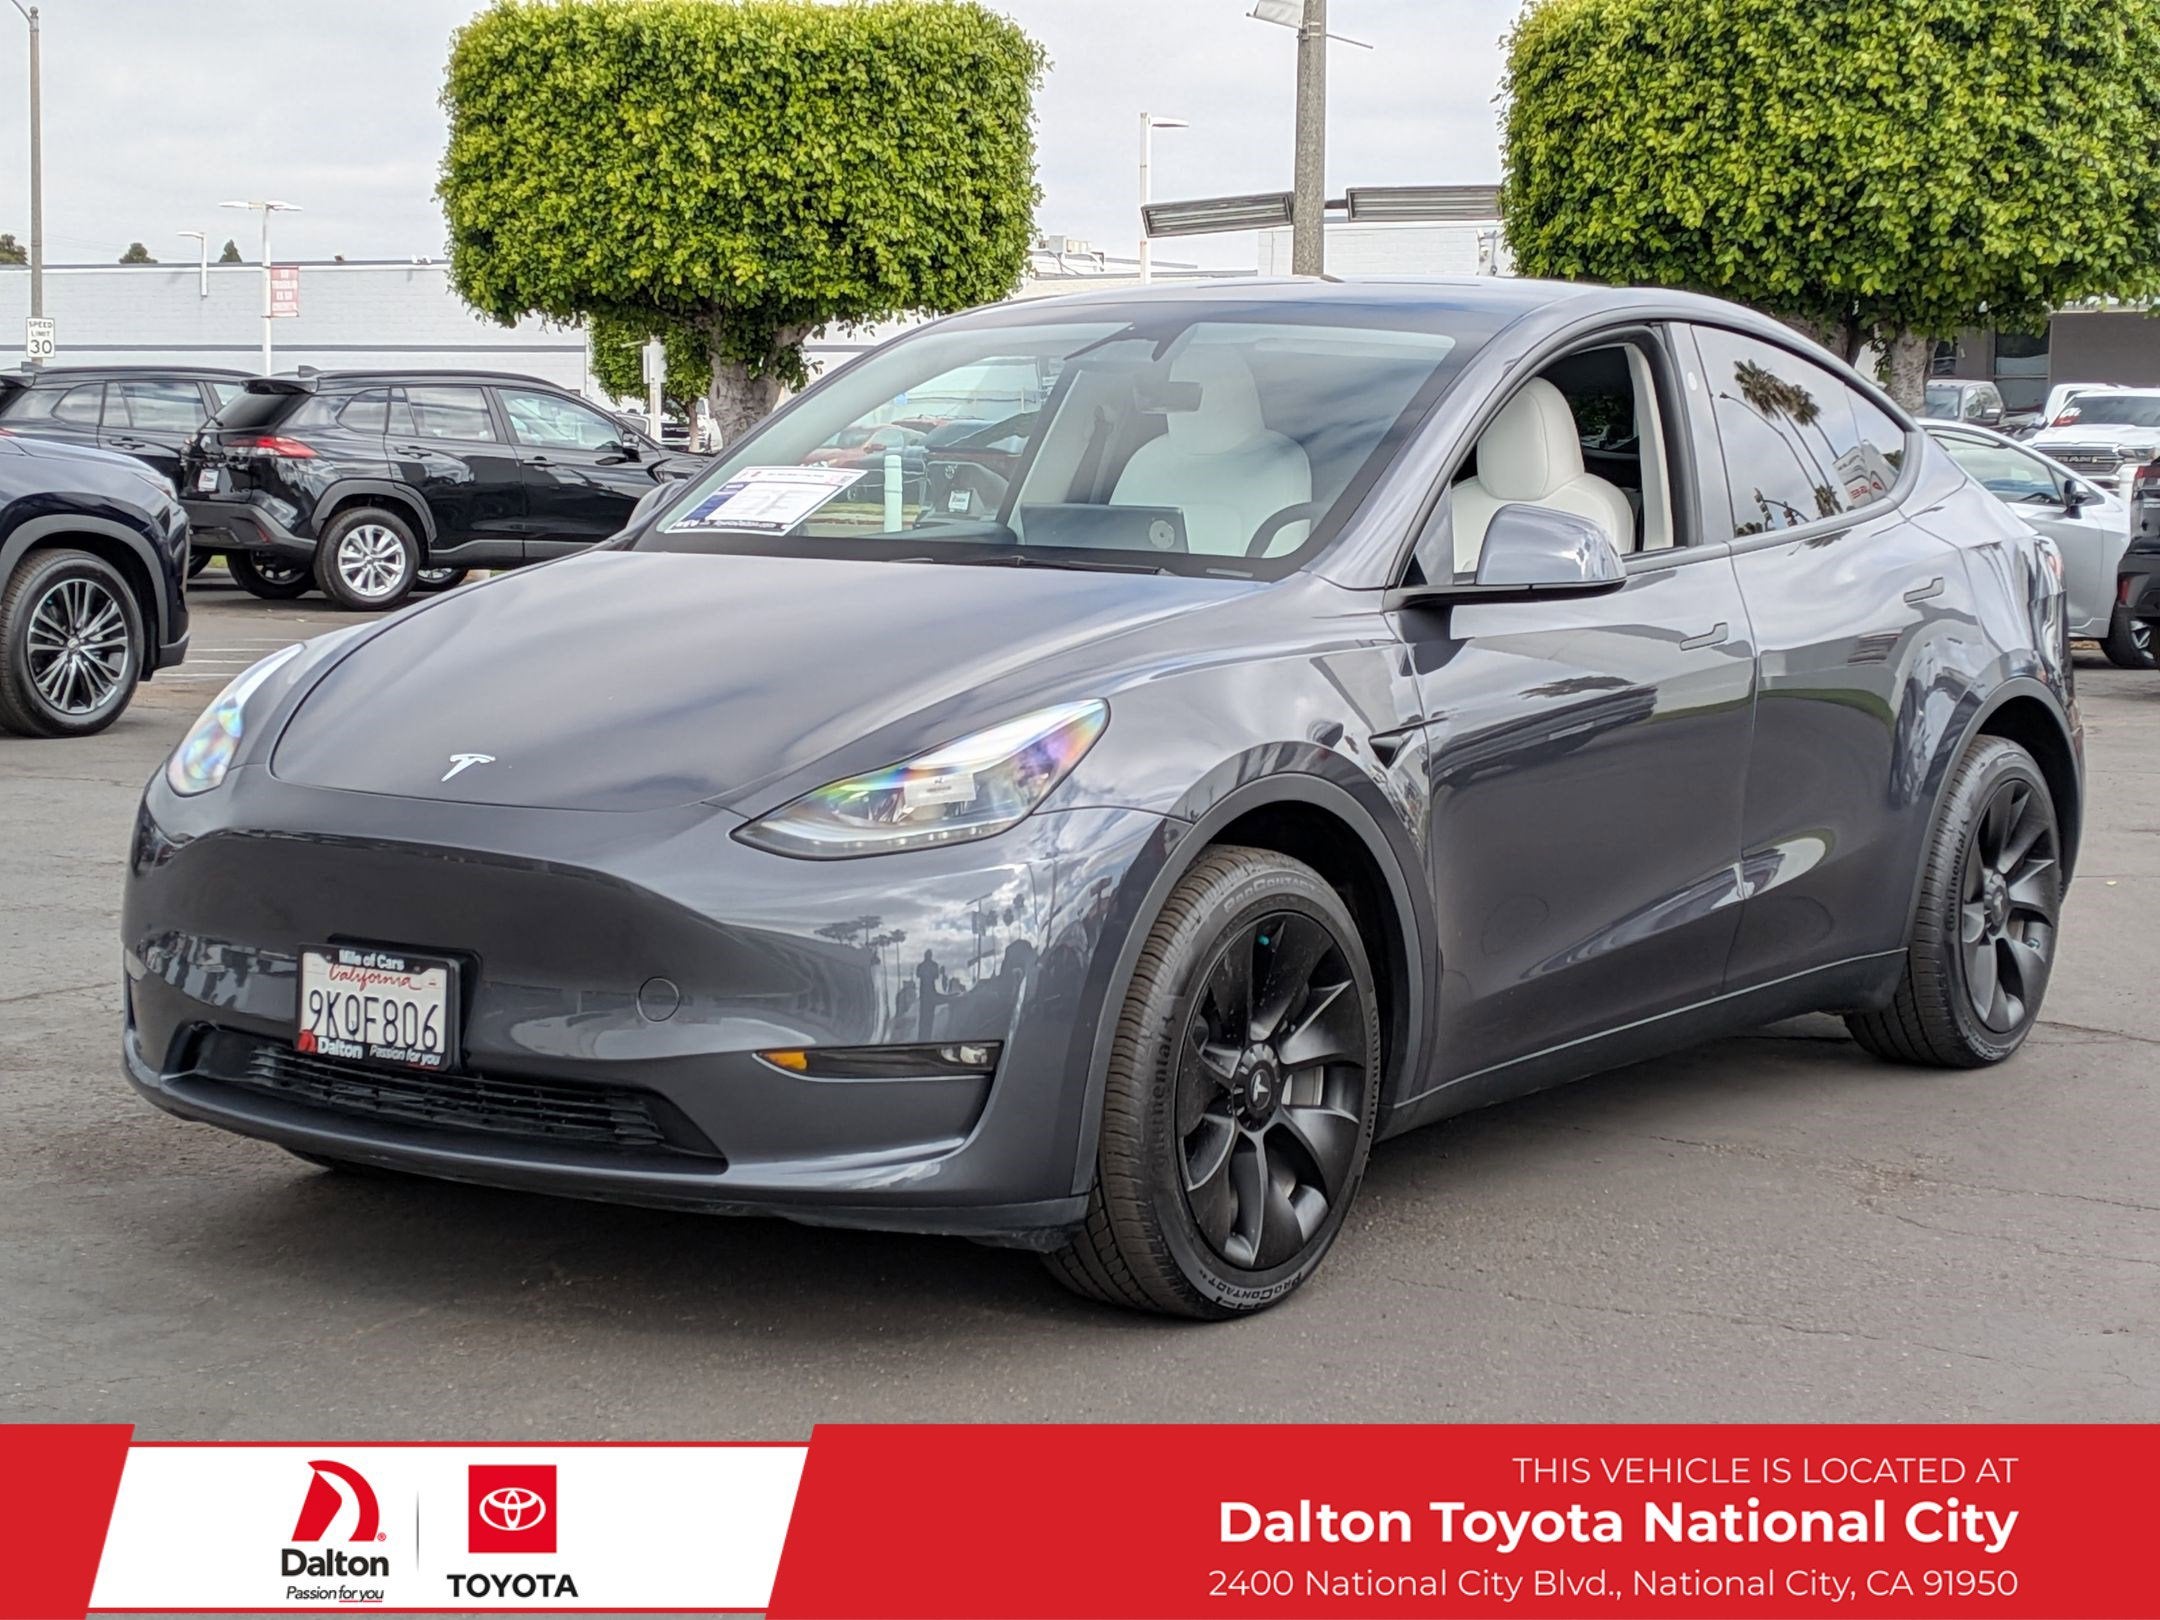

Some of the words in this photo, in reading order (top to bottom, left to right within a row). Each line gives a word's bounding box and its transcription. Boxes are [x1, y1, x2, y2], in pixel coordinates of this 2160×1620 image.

[30, 339, 53, 354] 30
[362, 953, 376, 967] of
[377, 954, 405, 971] Cars
[329, 964, 421, 992] California
[318, 1036, 364, 1060] Dalton
[369, 1044, 406, 1061] Passion
[406, 1048, 421, 1063] for
[421, 1053, 442, 1067] you
